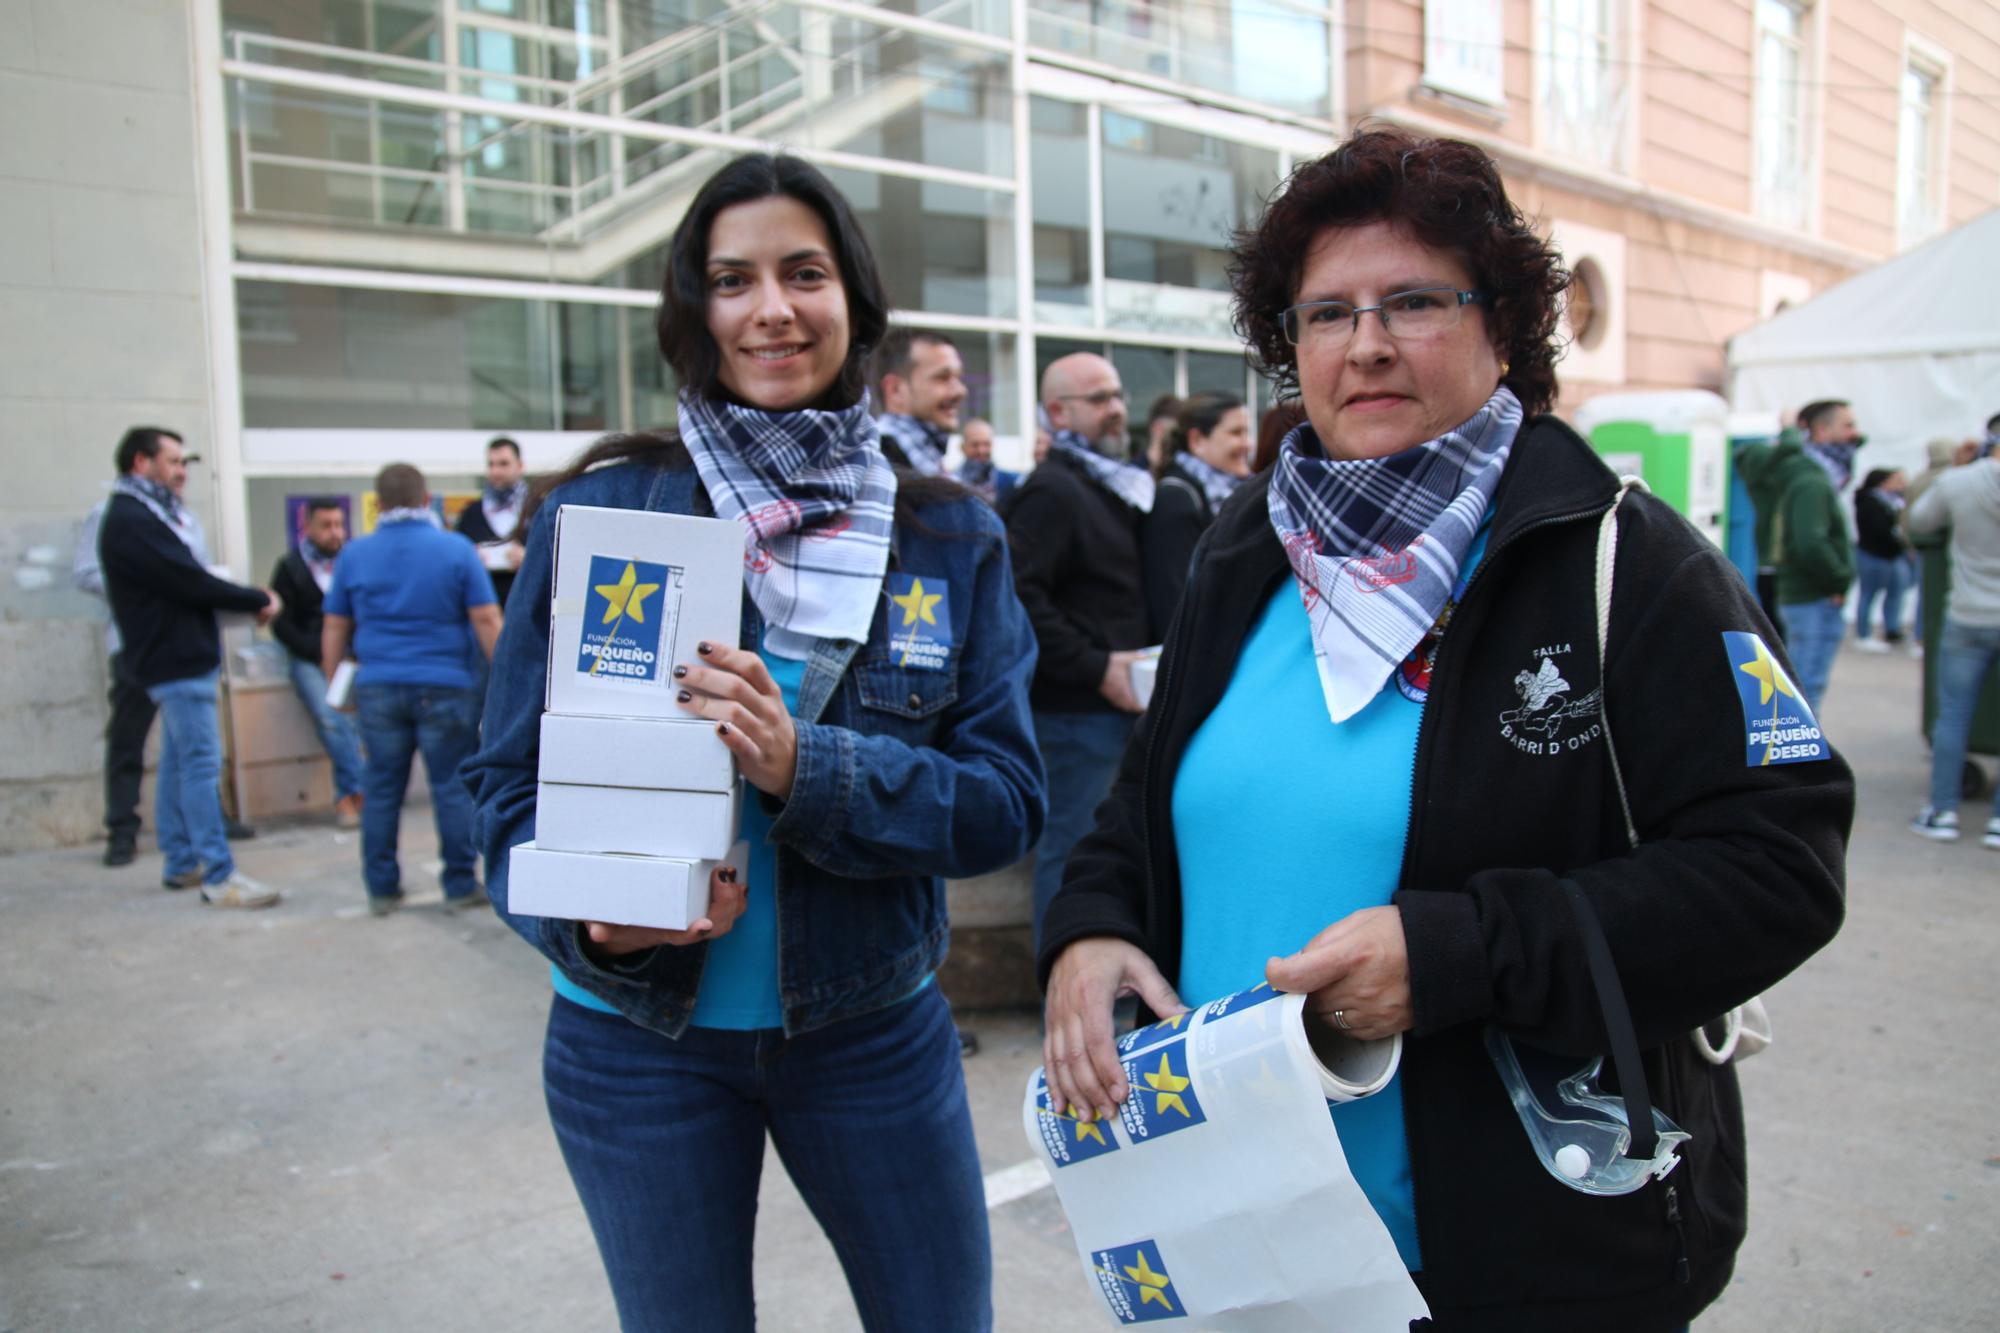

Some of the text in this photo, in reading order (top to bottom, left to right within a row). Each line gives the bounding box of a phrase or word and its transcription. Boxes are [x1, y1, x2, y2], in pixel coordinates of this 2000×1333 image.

[587, 633, 636, 646] FUNDACIÓN
[890, 640, 949, 658] PEQUEÑO
[581, 643, 655, 663] PEQUEÑO
[1533, 643, 1571, 659] FALLA
[597, 661, 647, 677] DESEO
[905, 654, 944, 669] DESEO
[1752, 715, 1800, 728] FUNDACIÓN
[1501, 724, 1543, 755] BARRI
[1749, 725, 1821, 745] PEQUEÑO
[1769, 743, 1821, 760] DESEO
[1120, 1103, 1136, 1134] SEO
[1039, 1111, 1060, 1159] DESEO
[1098, 1271, 1125, 1317] DESEO
[1100, 1252, 1136, 1321] PEQUEÑO
